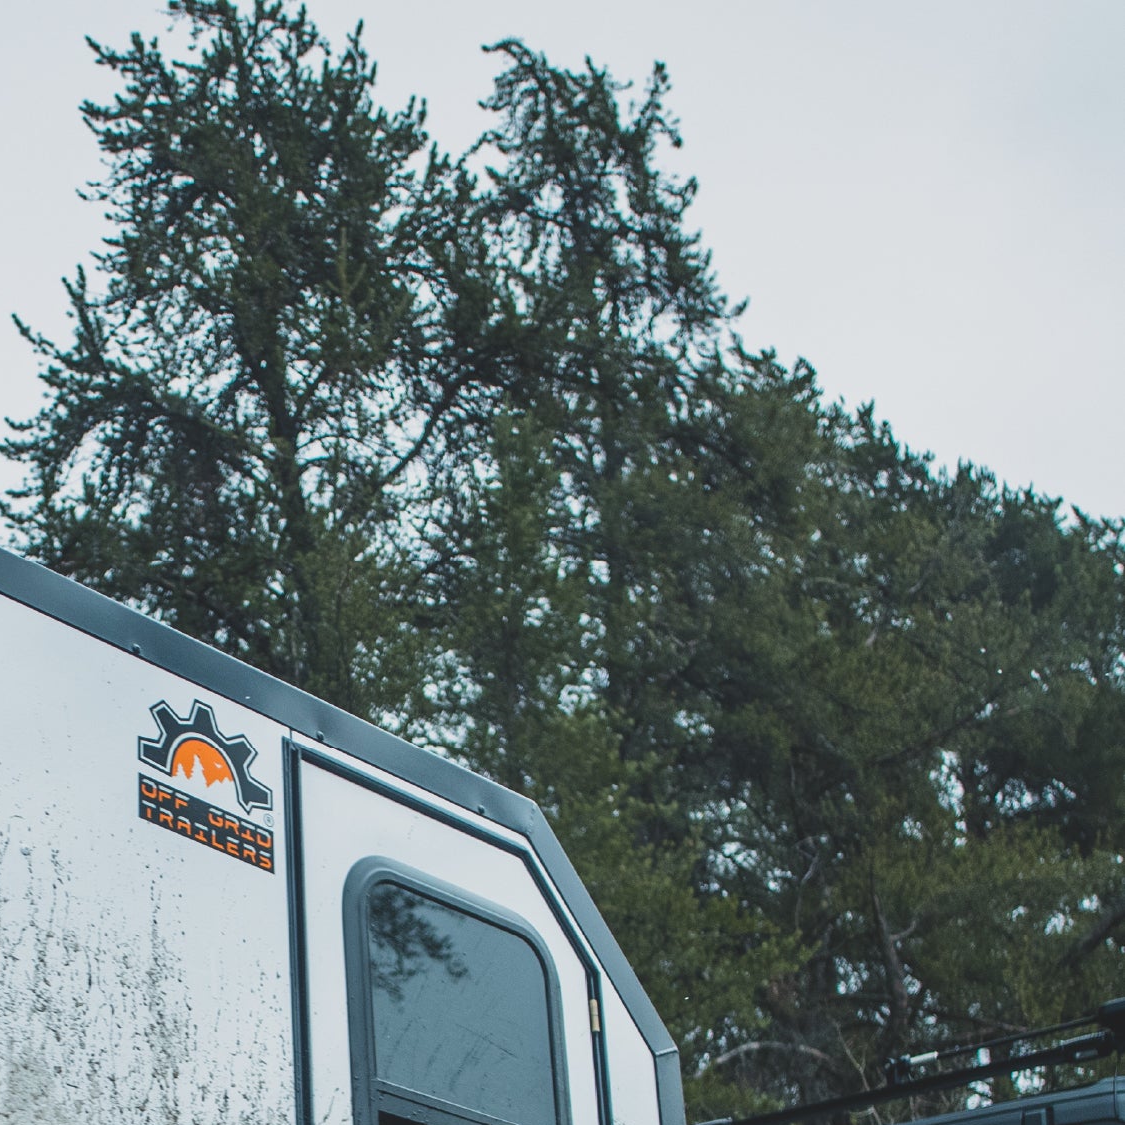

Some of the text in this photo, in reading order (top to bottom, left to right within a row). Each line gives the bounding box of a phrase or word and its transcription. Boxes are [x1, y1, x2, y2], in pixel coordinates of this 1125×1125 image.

[141, 779, 271, 848] OFF GRID
[142, 800, 272, 869] TRAILERS
